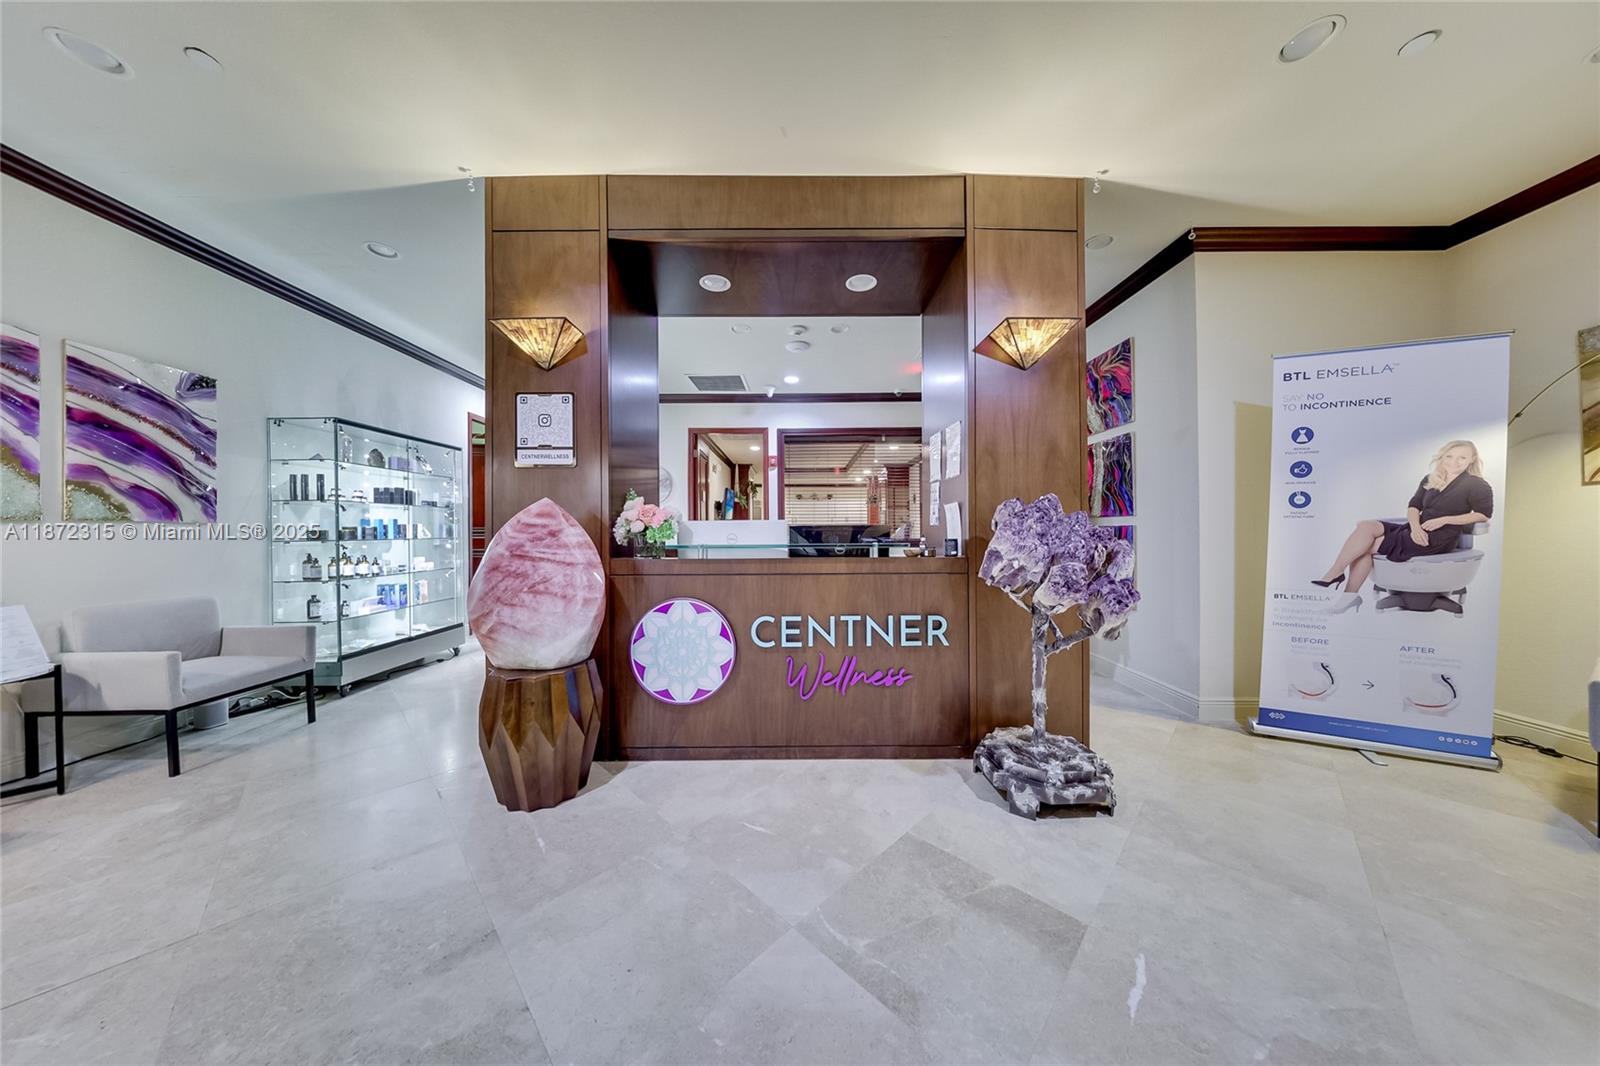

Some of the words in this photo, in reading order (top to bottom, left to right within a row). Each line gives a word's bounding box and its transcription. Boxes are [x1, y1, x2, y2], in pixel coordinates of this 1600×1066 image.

[1283, 371, 1311, 382] BTL
[1316, 363, 1393, 380] EMSELLA
[1306, 392, 1325, 401] NO
[1283, 403, 1297, 412] TO
[1300, 396, 1392, 411] INCONTINENCE
[1290, 593, 1330, 601] EMSELLA
[751, 614, 950, 648] CENTNER
[1291, 636, 1329, 645] BEFORE
[1399, 646, 1436, 654] AFTER
[785, 651, 914, 701] Wellness
